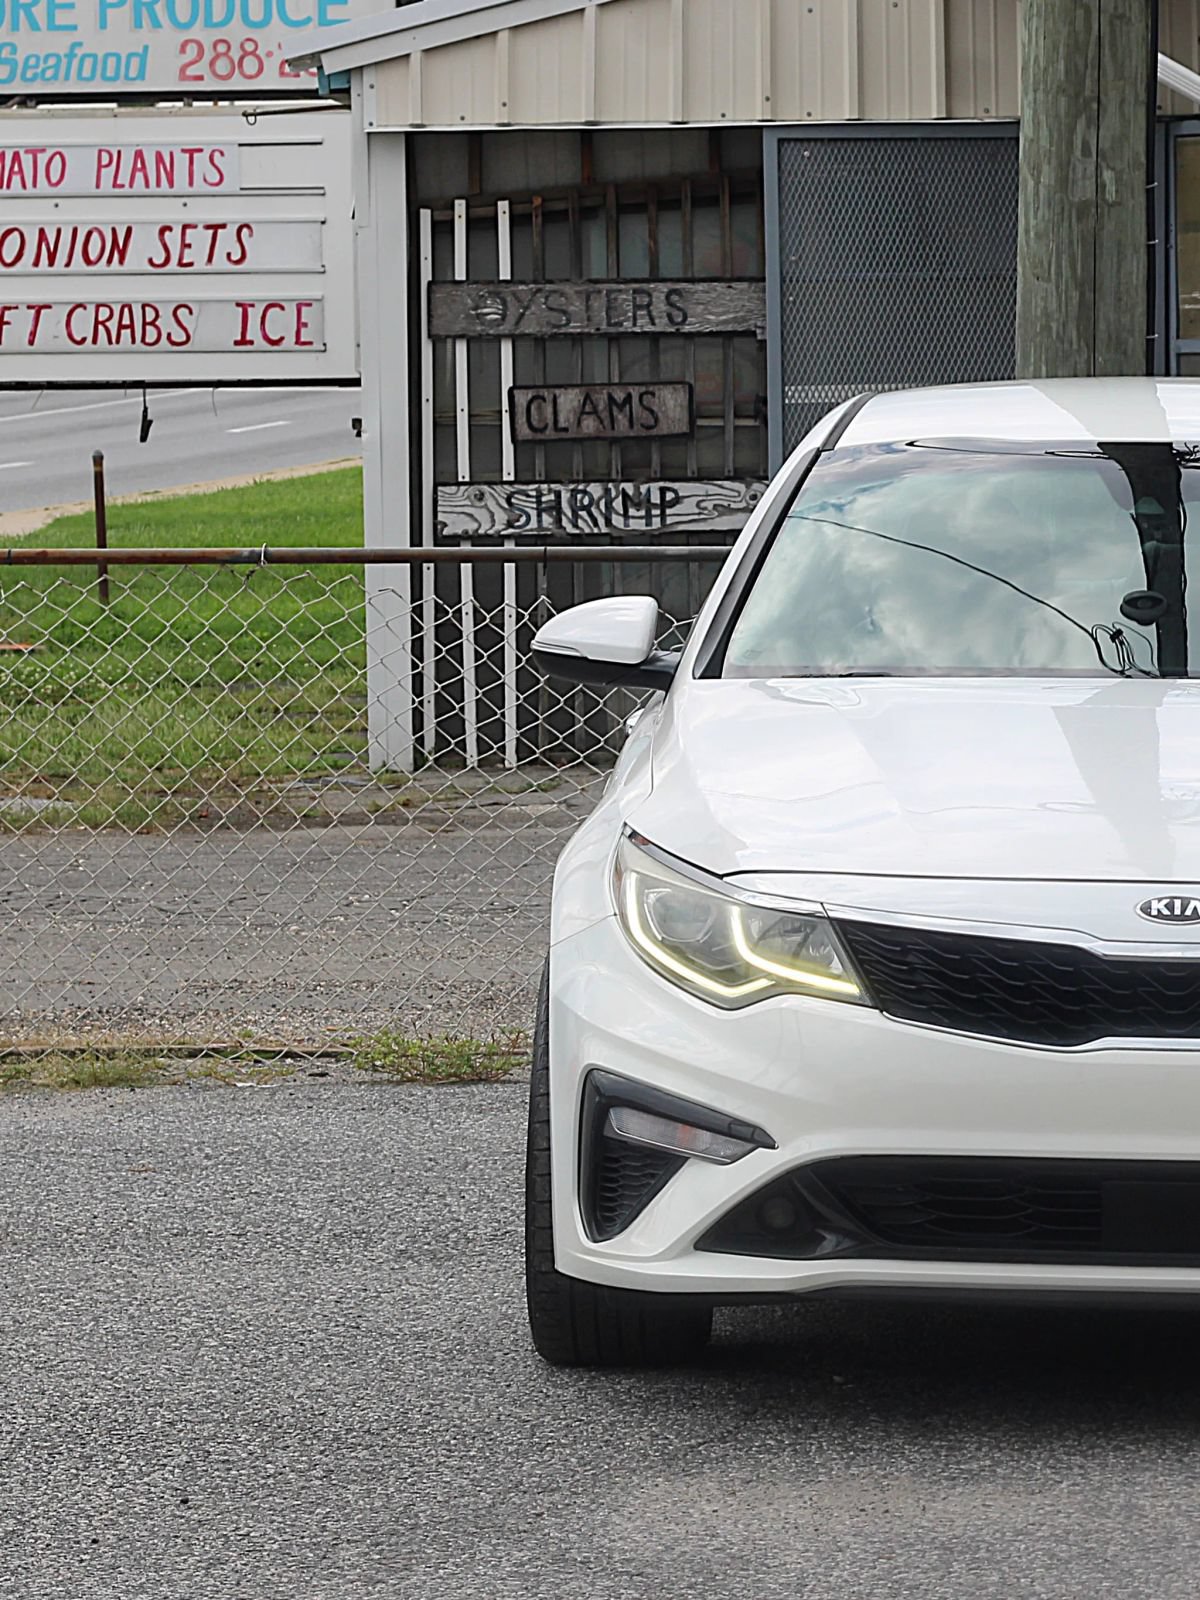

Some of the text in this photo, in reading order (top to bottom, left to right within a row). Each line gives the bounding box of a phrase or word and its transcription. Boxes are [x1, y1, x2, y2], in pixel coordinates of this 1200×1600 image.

[0, 41, 149, 85] Seafood
[95, 148, 226, 190] PLANTS
[0, 223, 254, 268] ONION SETS
[65, 302, 194, 347] CRABS
[233, 302, 314, 346] ICE
[475, 287, 690, 328] OYSTERS
[525, 390, 660, 434] CLAMS
[505, 485, 681, 530] SHRIMP
